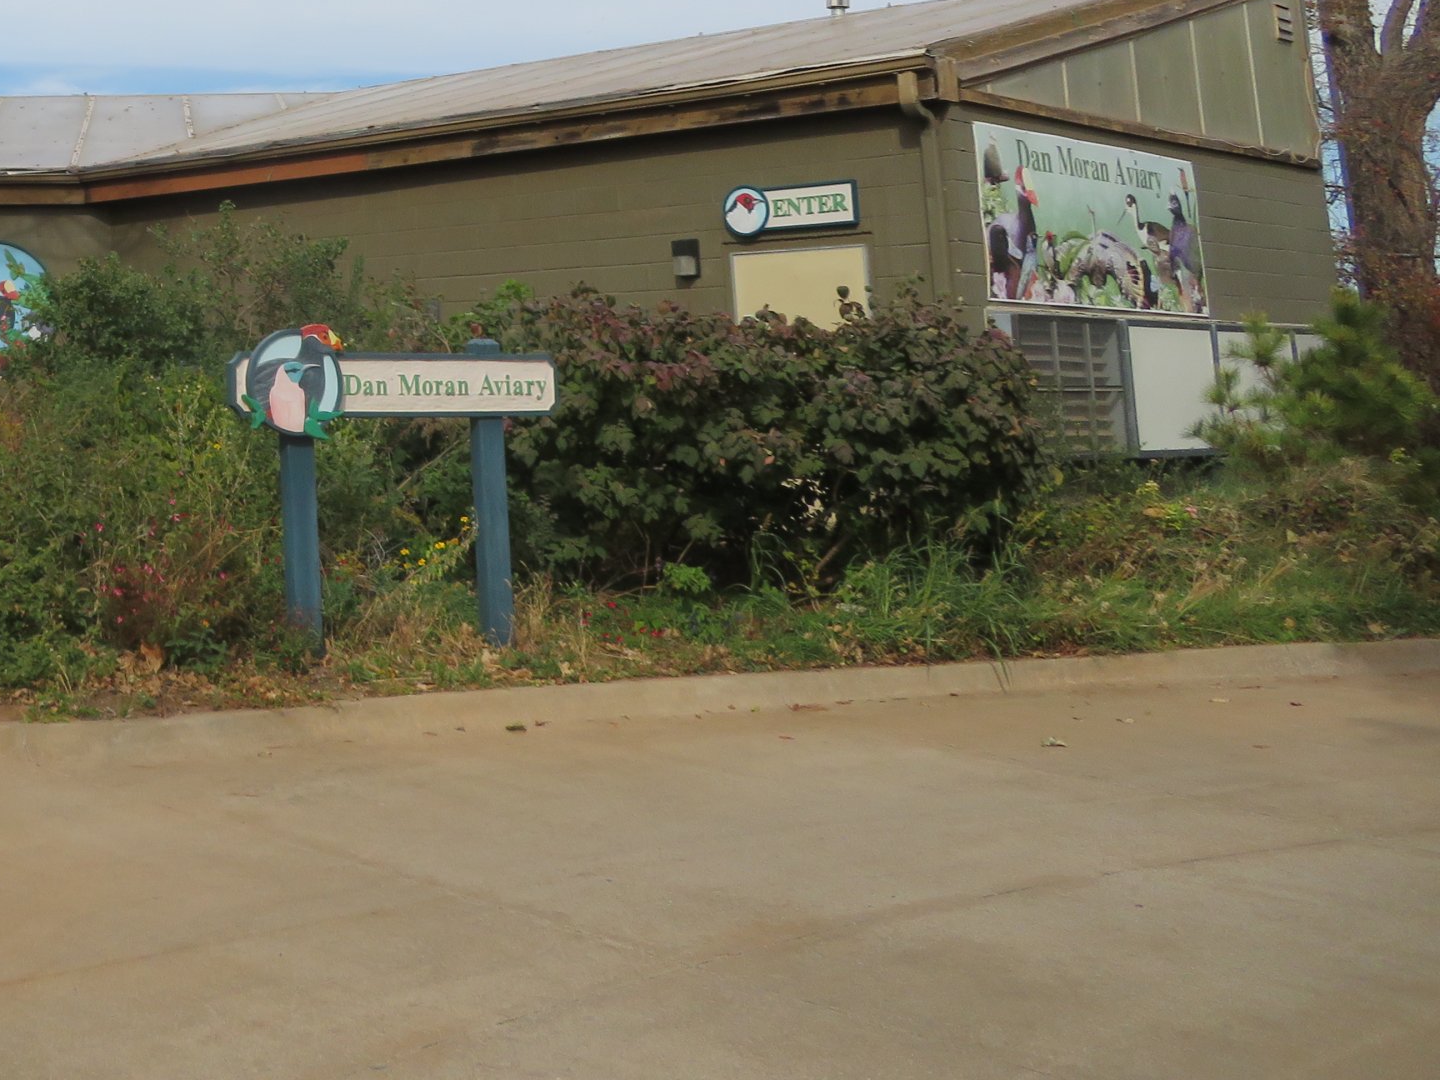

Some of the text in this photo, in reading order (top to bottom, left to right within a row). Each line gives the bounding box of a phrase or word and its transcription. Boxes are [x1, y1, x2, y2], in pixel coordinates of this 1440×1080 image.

[1015, 139, 1163, 199] Dan Moran Aviary
[771, 192, 848, 218] ENTER
[342, 374, 547, 400] Dan Moran Aviary
